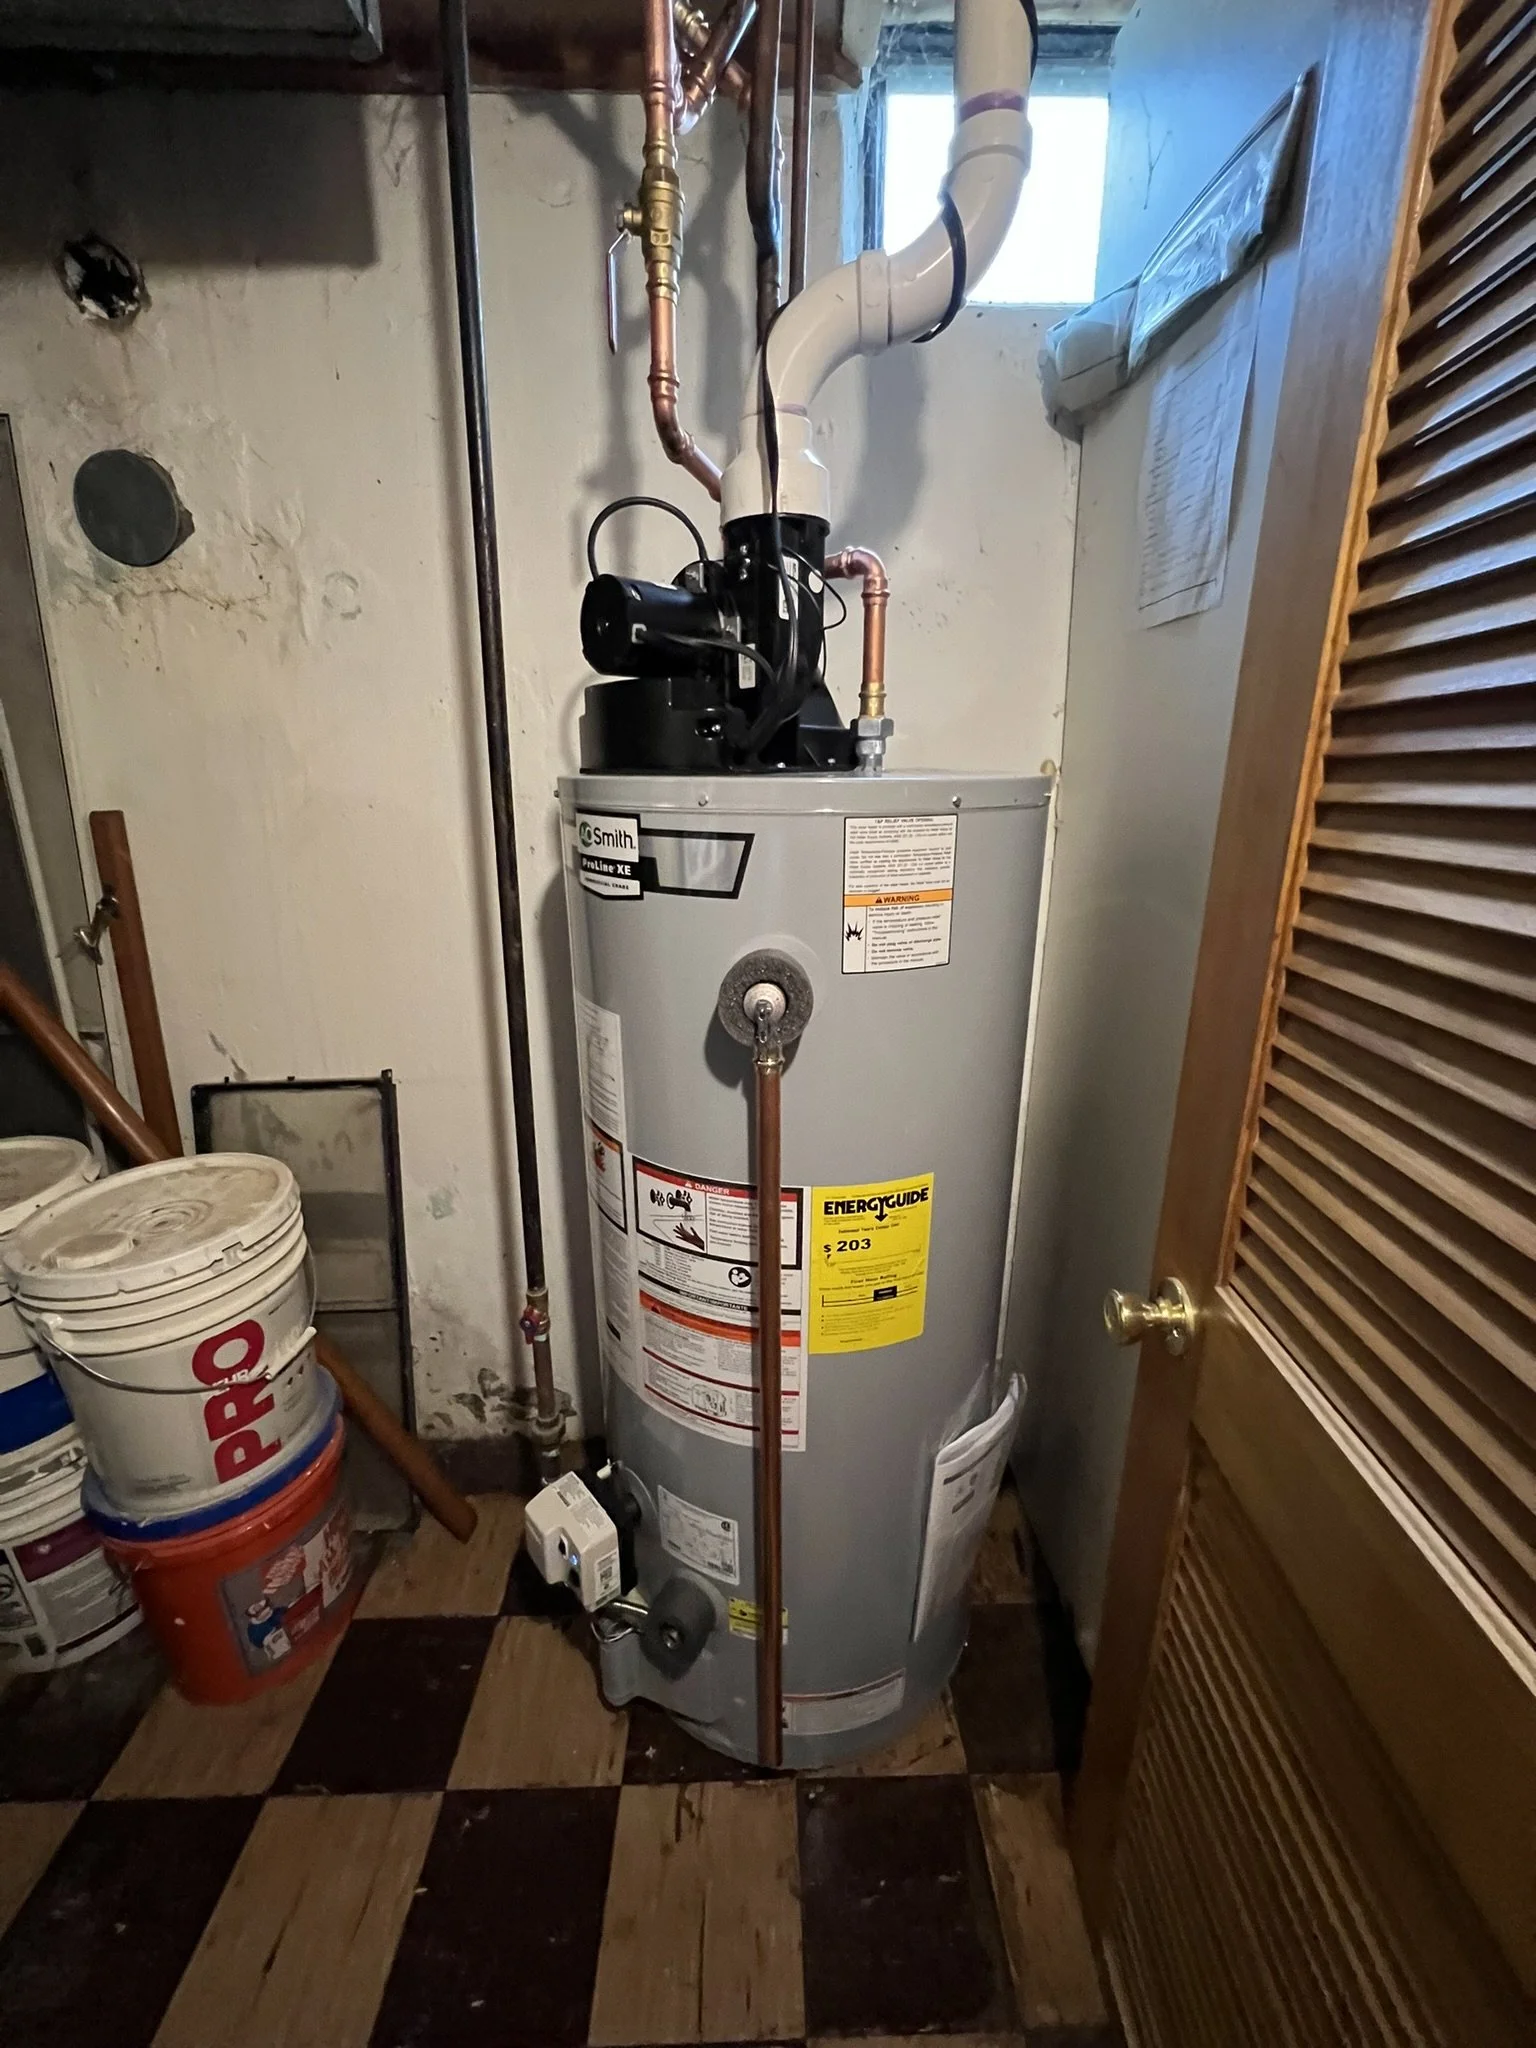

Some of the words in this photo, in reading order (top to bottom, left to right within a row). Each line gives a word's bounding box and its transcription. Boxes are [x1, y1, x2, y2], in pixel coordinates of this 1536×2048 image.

[593, 827, 634, 850] Smith
[617, 864, 631, 876] XE
[883, 894, 920, 904] WARNING
[694, 1183, 730, 1196] DANGER
[836, 1238, 871, 1252] 203
[192, 1319, 282, 1484] PRO
